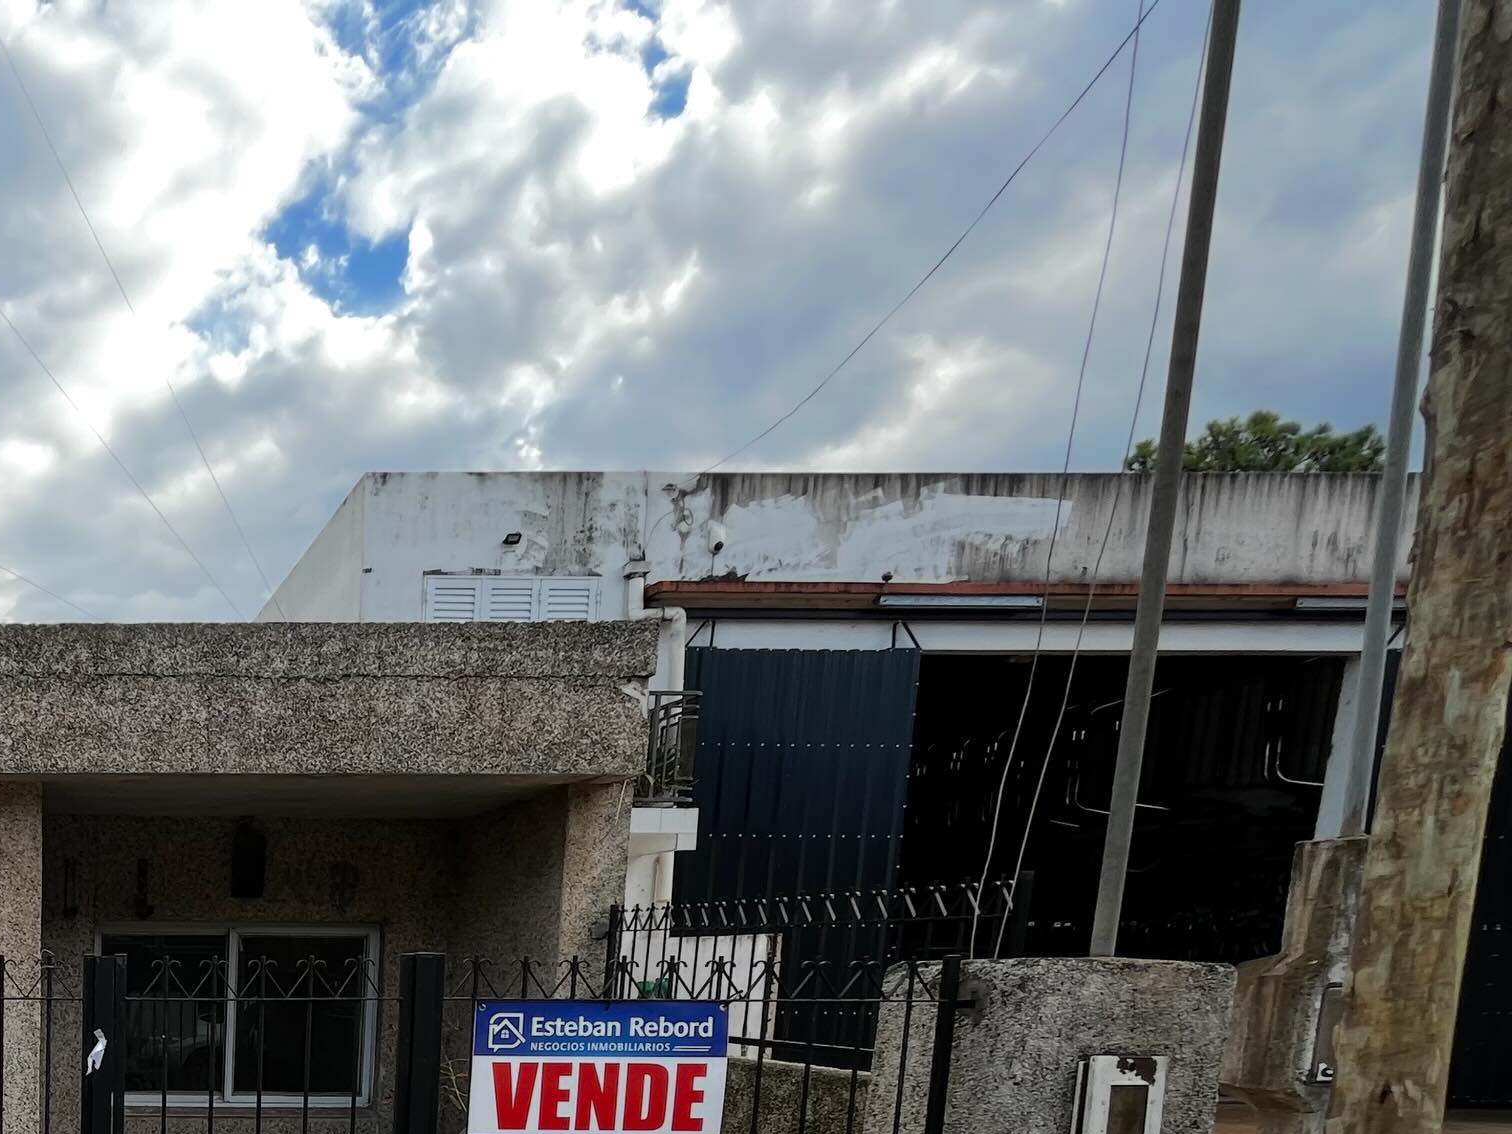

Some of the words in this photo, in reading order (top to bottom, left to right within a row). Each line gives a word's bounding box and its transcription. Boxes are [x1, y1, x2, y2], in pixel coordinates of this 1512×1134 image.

[531, 1015, 620, 1037] Esteban
[630, 1016, 713, 1037] Rebord
[530, 1042, 585, 1051] NEGOCIOS
[587, 1042, 671, 1052] INMOBILIARIOS
[492, 1062, 708, 1131] VENDE
